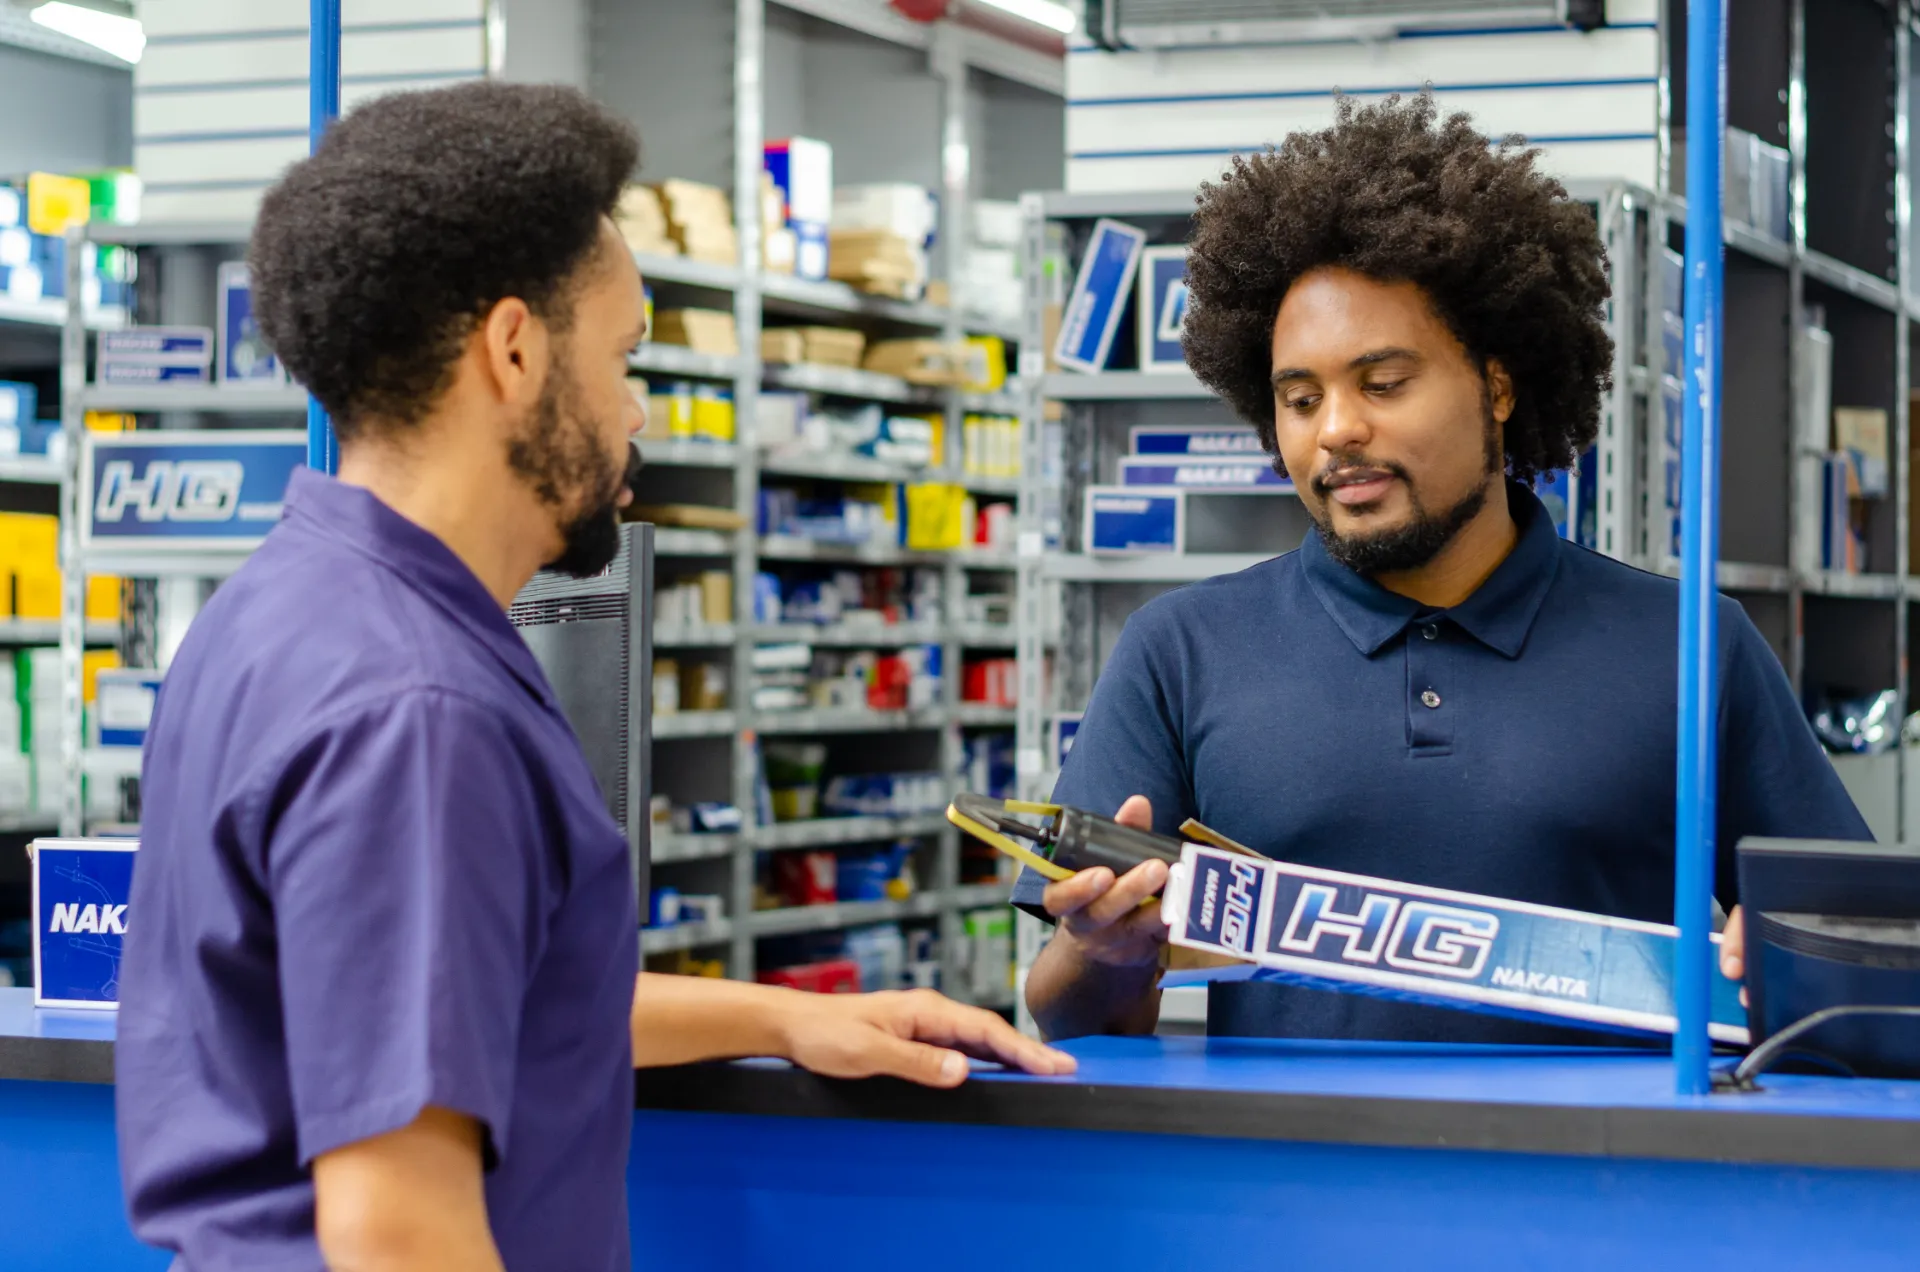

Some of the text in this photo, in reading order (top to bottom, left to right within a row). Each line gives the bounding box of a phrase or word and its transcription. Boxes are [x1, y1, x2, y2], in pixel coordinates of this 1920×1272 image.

[94, 460, 244, 522] HG
[49, 902, 129, 935] NAK
[1220, 859, 1257, 953] HG
[1279, 882, 1499, 979] HG
[1490, 966, 1588, 998] NAKATA
